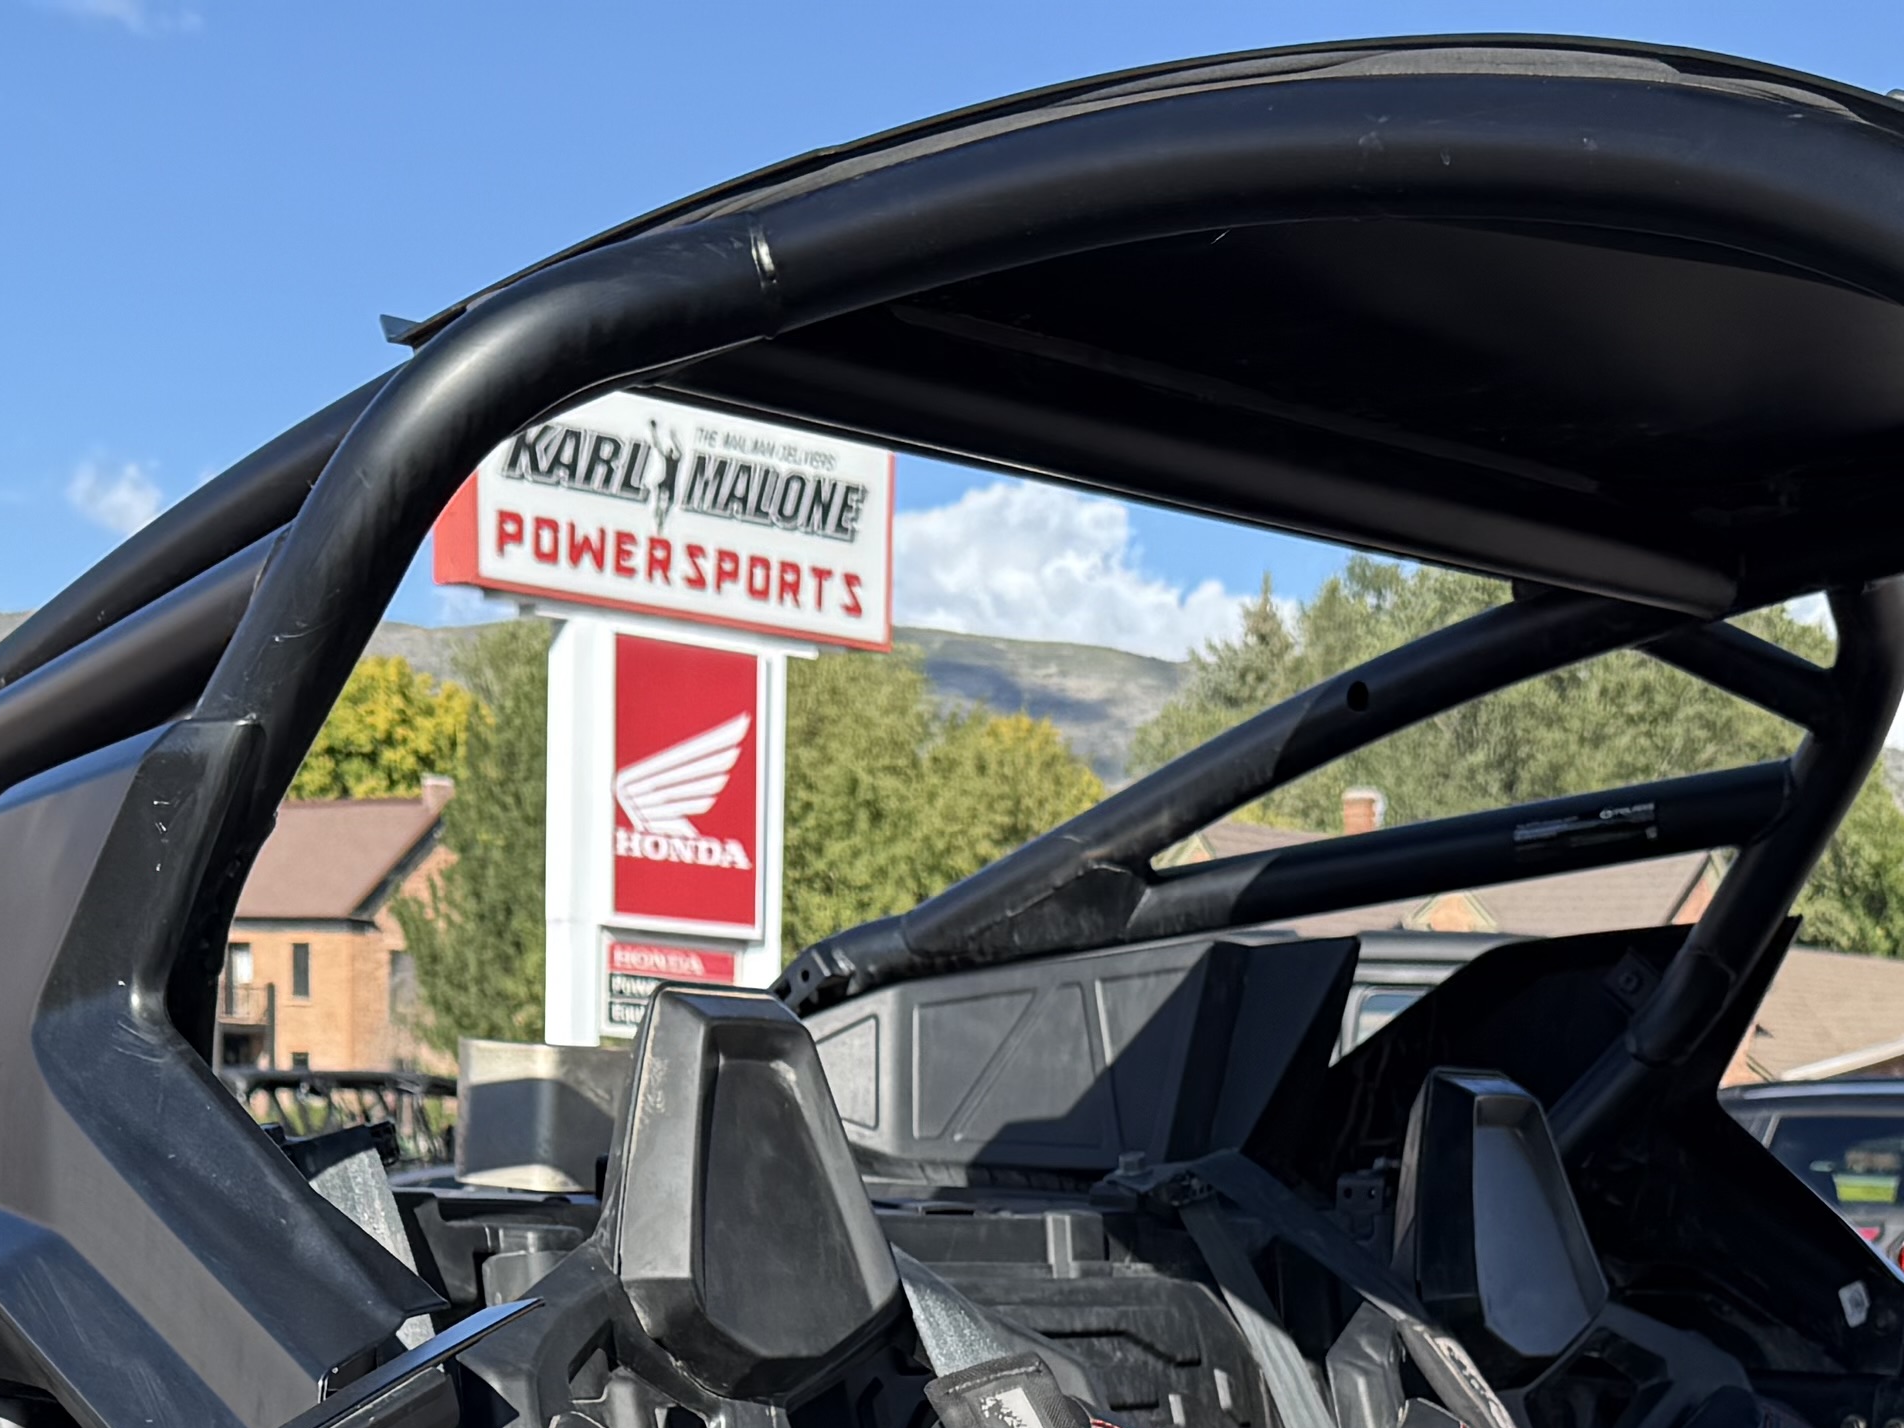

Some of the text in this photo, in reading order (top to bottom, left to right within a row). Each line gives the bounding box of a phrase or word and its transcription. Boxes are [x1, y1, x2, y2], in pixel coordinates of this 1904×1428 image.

[498, 424, 868, 543] KARL MALONE
[496, 509, 863, 618] POWERSPORTS
[615, 828, 753, 870] HONDA
[613, 945, 706, 976] HONDA
